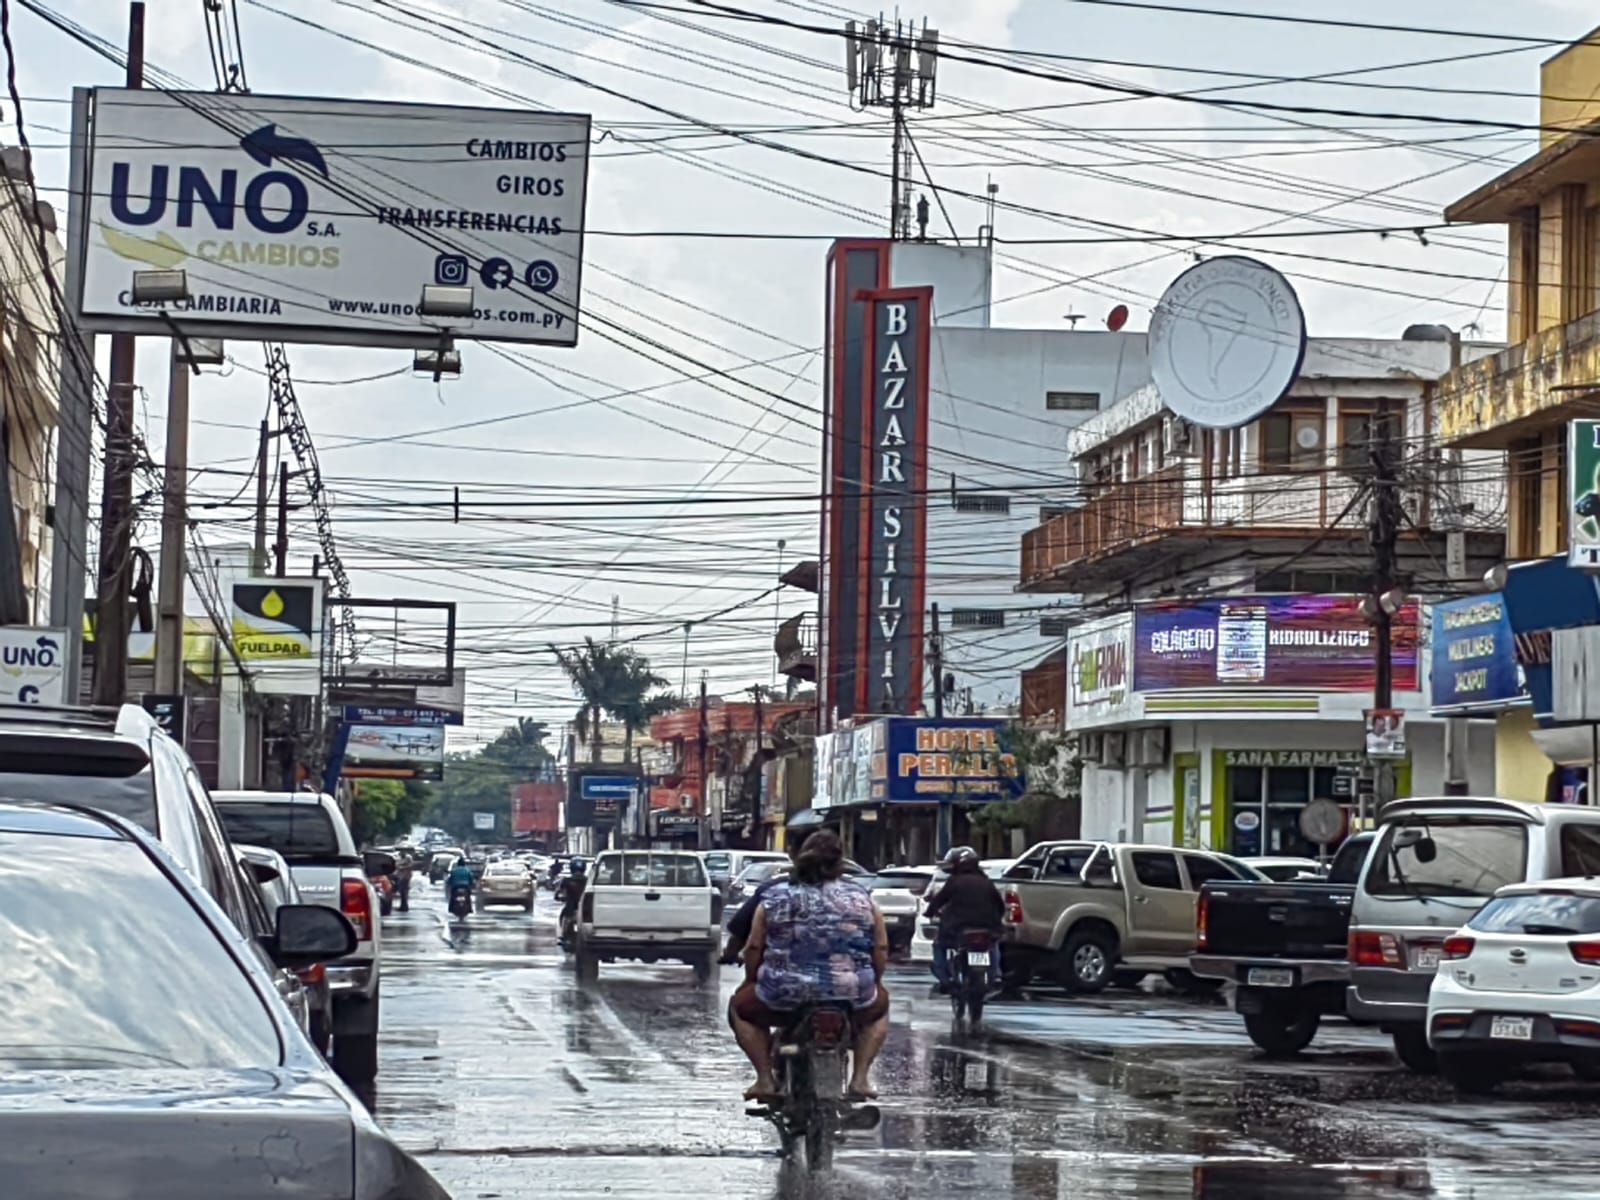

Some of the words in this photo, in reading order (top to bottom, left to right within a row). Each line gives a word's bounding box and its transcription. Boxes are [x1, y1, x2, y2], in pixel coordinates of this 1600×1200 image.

[466, 138, 567, 163] CAMBIOS
[109, 161, 310, 235] UNO
[496, 174, 565, 198] GIROS
[306, 221, 341, 239] S.A.
[376, 204, 563, 236] TRANSFERENCIAS
[196, 239, 341, 270] CAMBIOS
[174, 293, 282, 316] CAMBIARIA
[327, 298, 567, 329] www.unocos.com.py
[879, 303, 908, 483] BAZAR
[3, 645, 54, 668] UNO
[240, 642, 301, 655] FUELPAR
[916, 727, 1000, 751] HOTEL
[1226, 751, 1274, 767] SANA
[1277, 751, 1338, 767] FARMA
